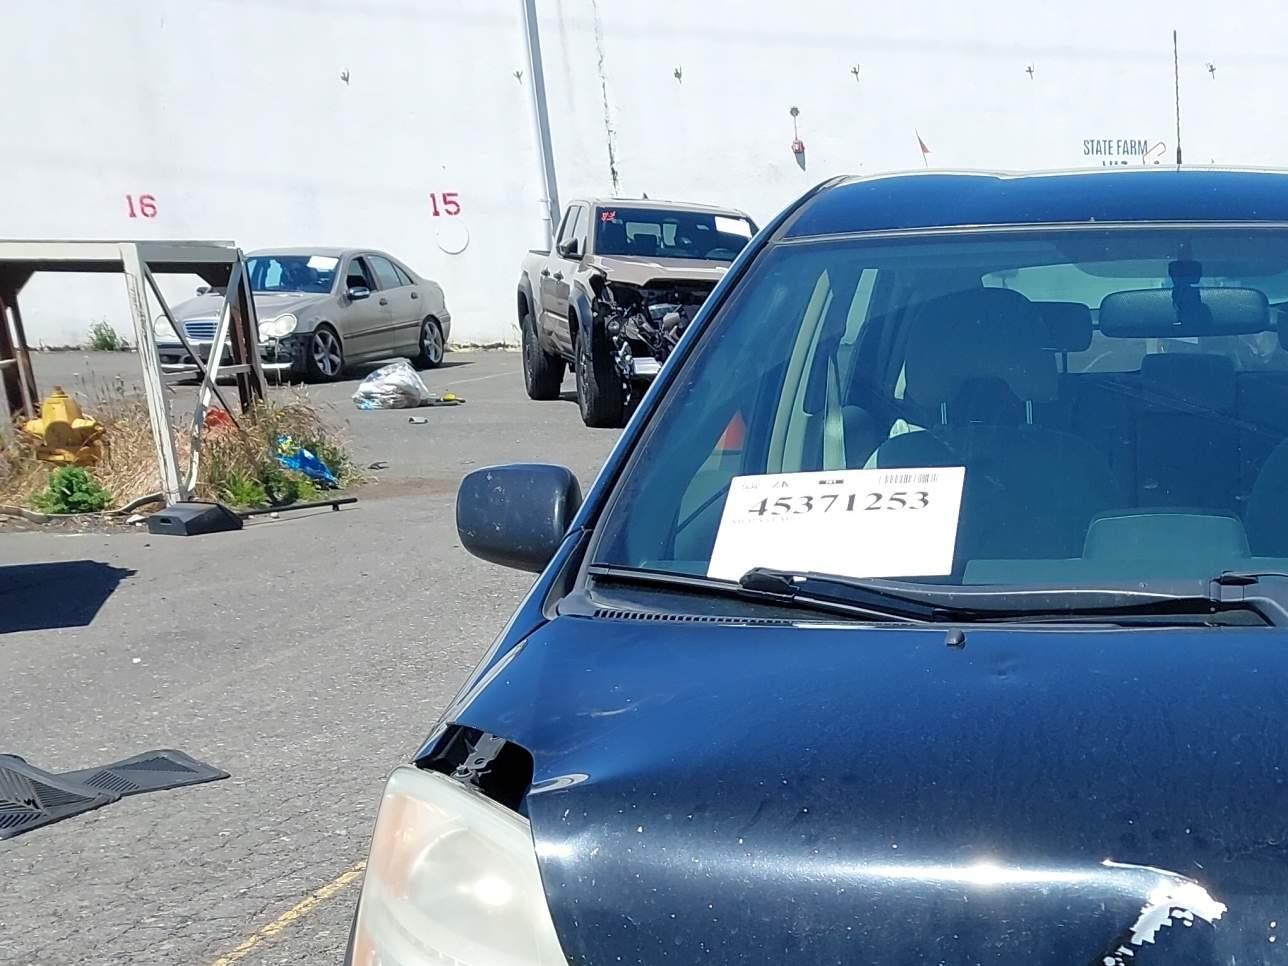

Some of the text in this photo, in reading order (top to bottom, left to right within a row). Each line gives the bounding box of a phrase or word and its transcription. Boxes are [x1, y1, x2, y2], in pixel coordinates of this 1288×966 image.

[1083, 138, 1149, 156] STATE FARM
[126, 194, 157, 217] 16
[429, 192, 461, 217] 15
[748, 490, 930, 517] 45371253
